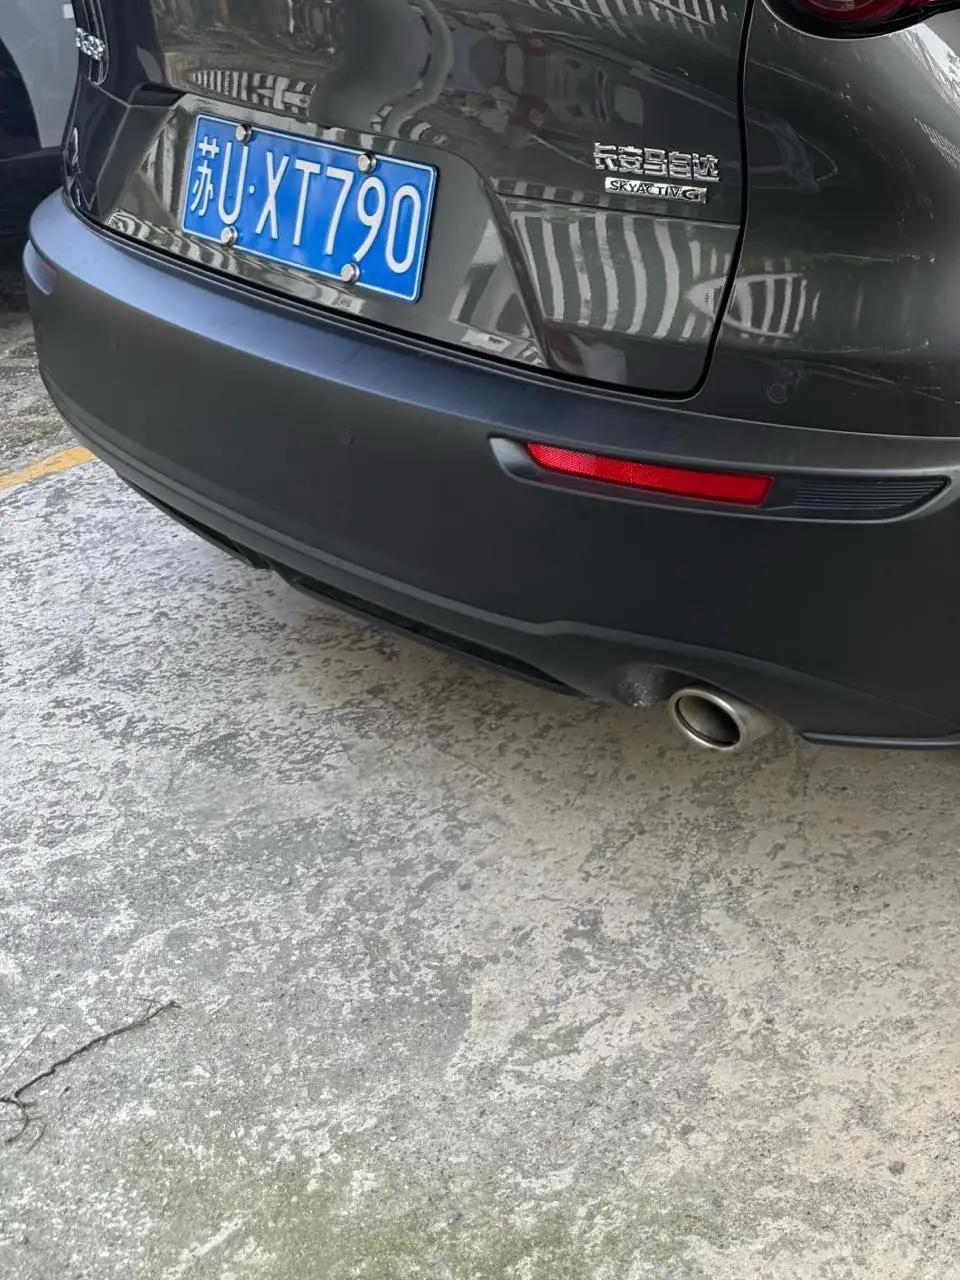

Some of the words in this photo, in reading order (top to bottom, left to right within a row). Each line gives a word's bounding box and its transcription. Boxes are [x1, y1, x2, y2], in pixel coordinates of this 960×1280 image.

[593, 142, 720, 182] 长安马自达
